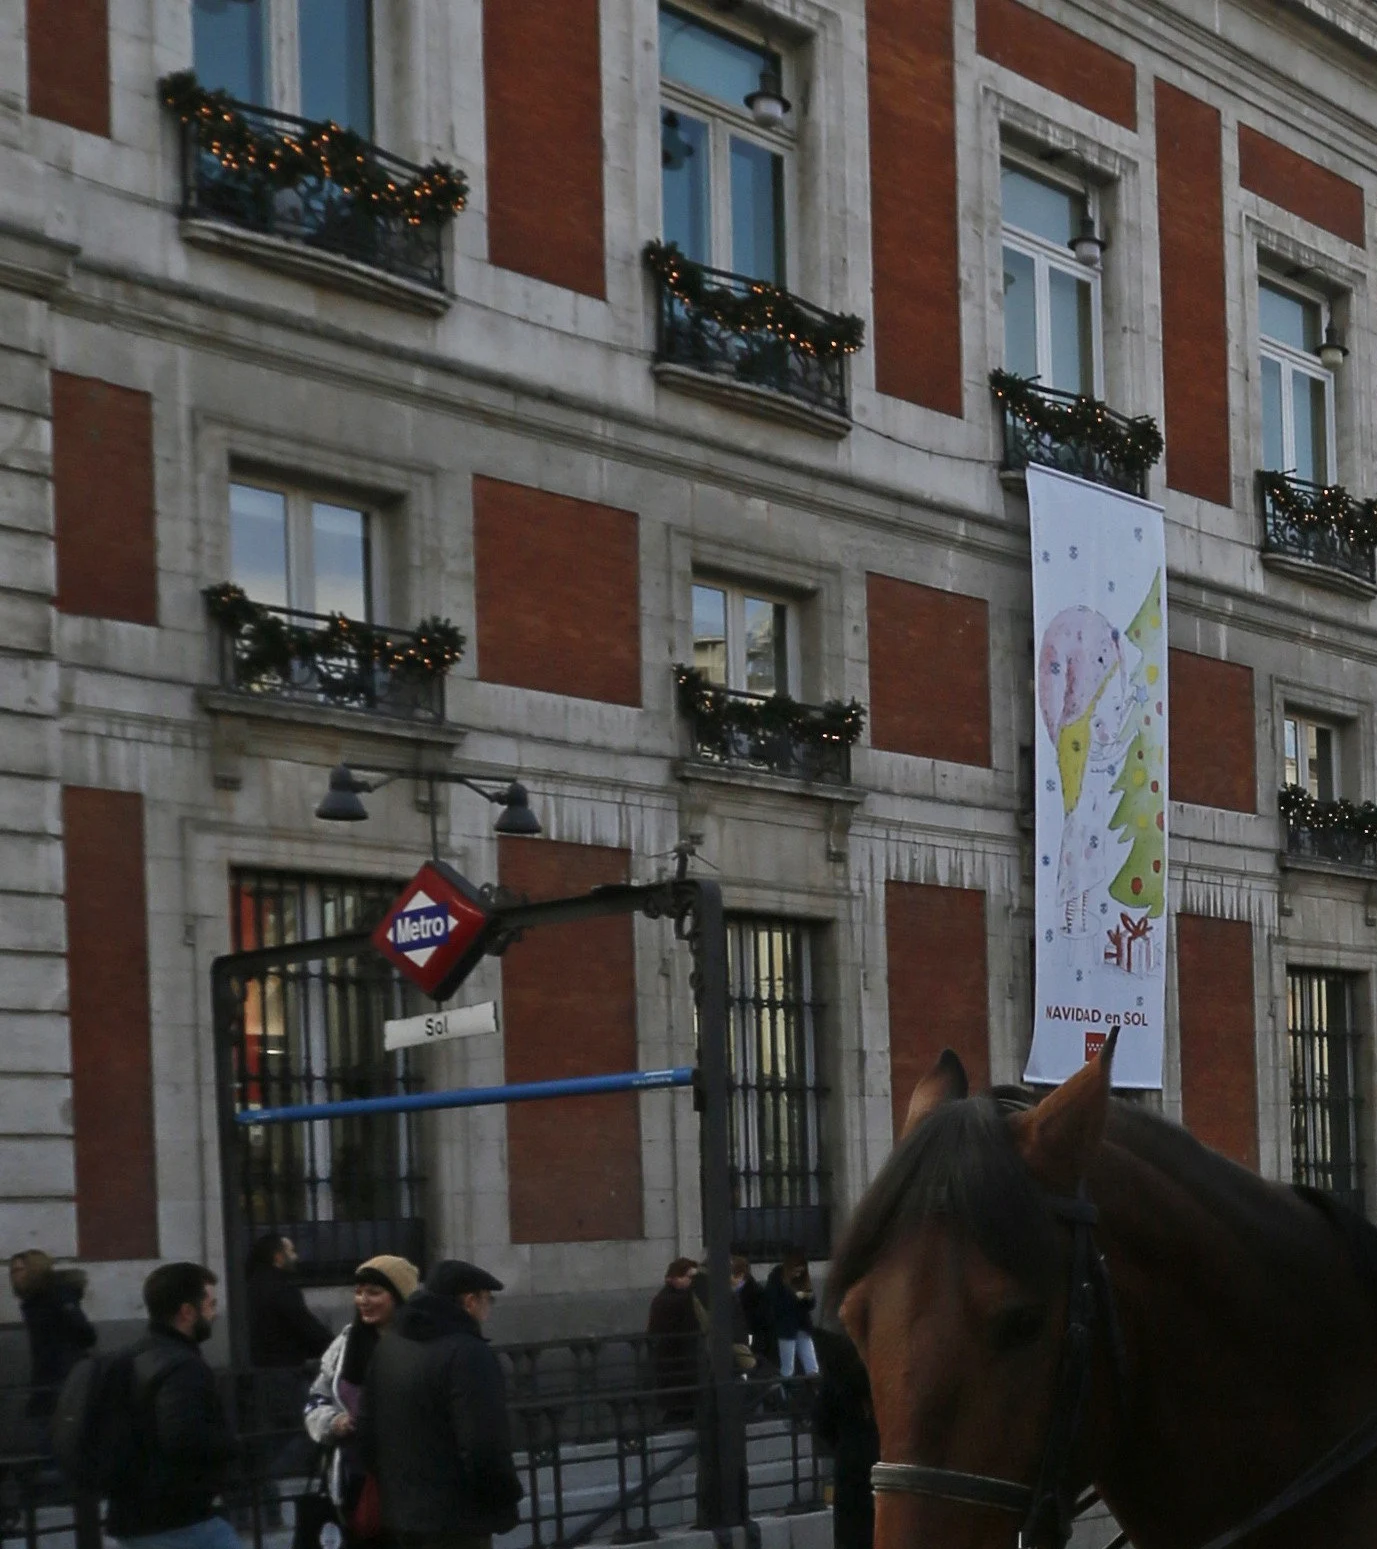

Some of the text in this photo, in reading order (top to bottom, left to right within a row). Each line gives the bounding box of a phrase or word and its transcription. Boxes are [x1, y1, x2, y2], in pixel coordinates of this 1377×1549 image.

[396, 916, 445, 945] Metro
[1046, 1005, 1148, 1026] NAVIDAD en SOL
[425, 1018, 448, 1037] Sol
